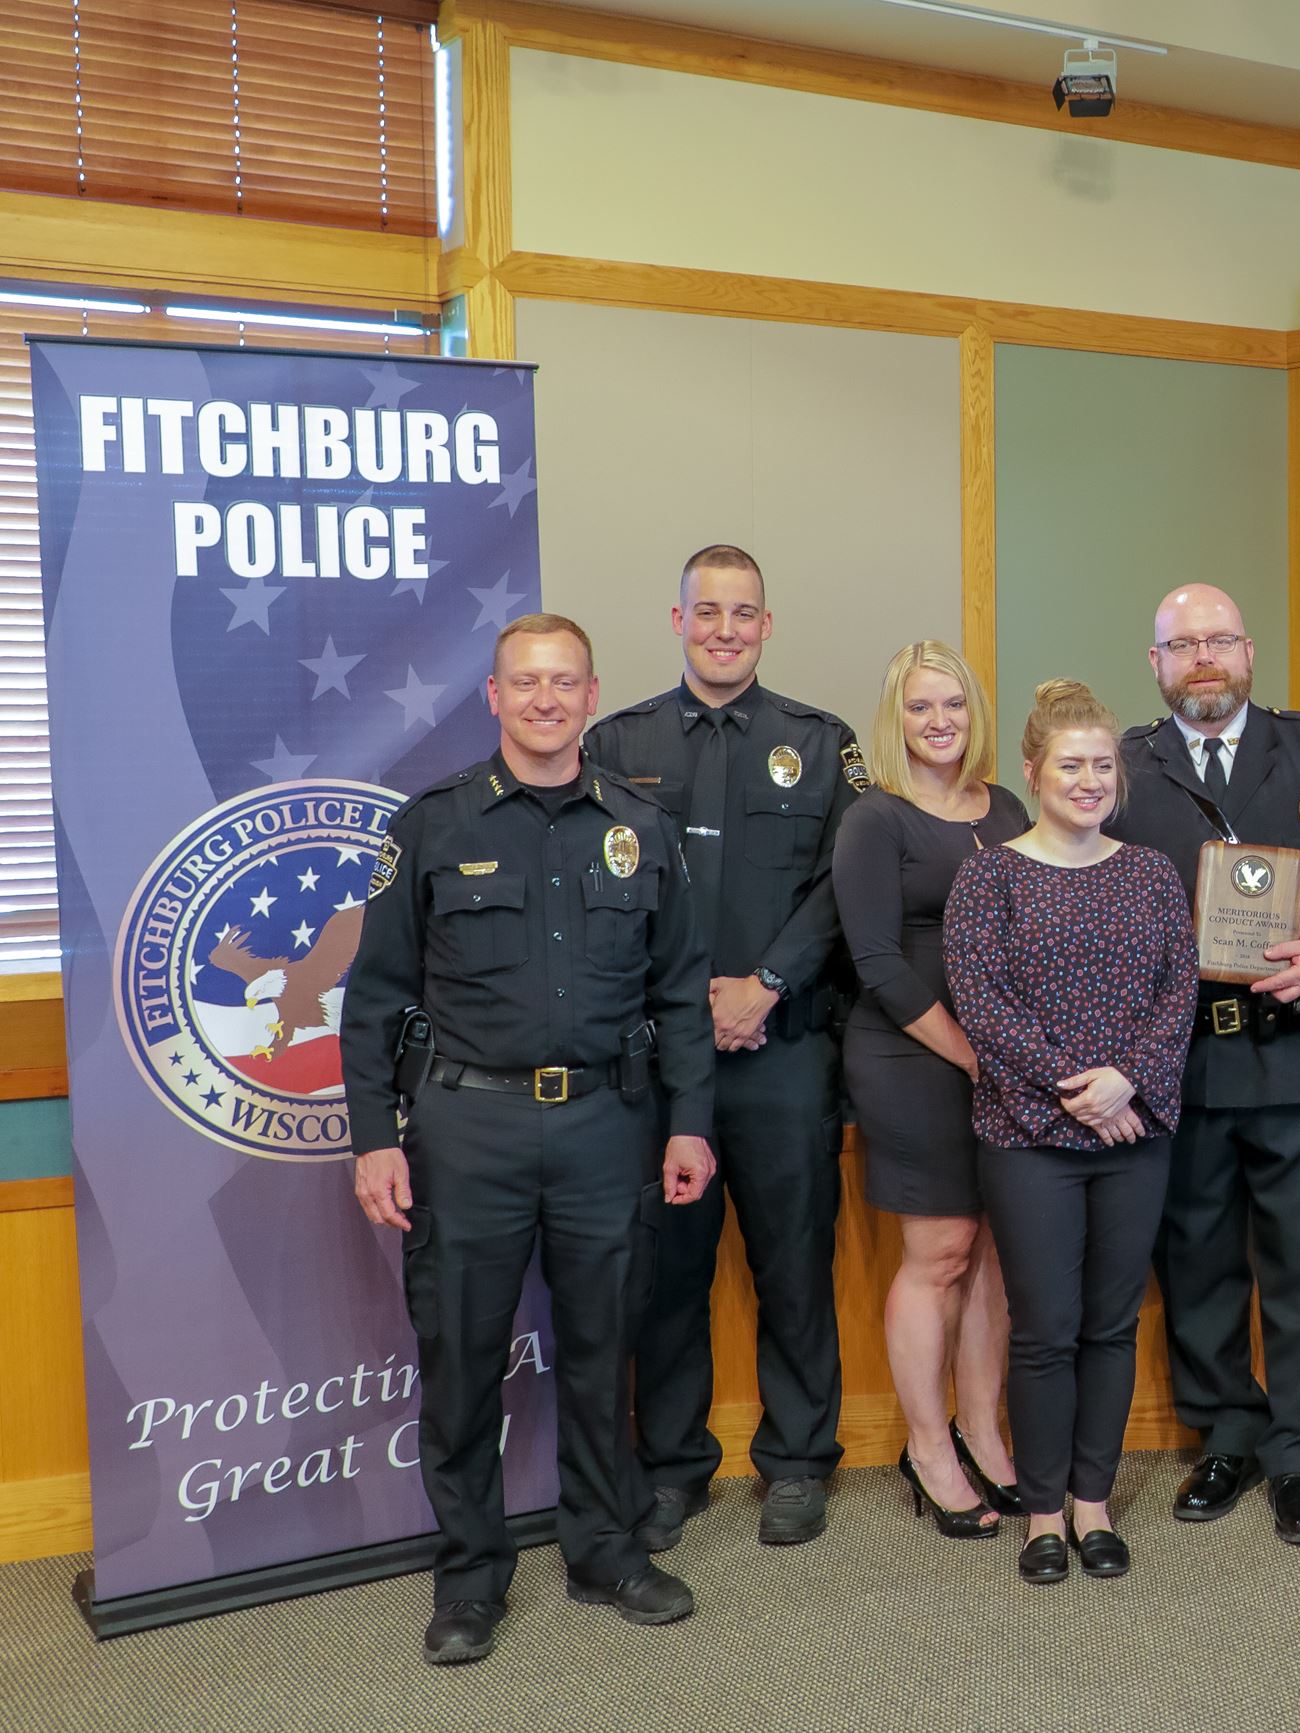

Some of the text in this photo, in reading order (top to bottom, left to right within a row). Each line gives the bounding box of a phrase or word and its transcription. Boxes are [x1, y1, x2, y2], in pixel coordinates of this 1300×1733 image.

[78, 394, 502, 485] FITCHBURG
[172, 500, 430, 581] POLICE
[137, 798, 363, 1034] FITCHBURG POLICE
[1208, 915, 1287, 929] CONDUCT AWARD
[1212, 936, 1234, 946] Sean
[1236, 938, 1248, 948] M.
[1217, 907, 1280, 920] MERITORIOUS
[502, 1330, 551, 1381] A
[177, 1435, 364, 1523] Great
